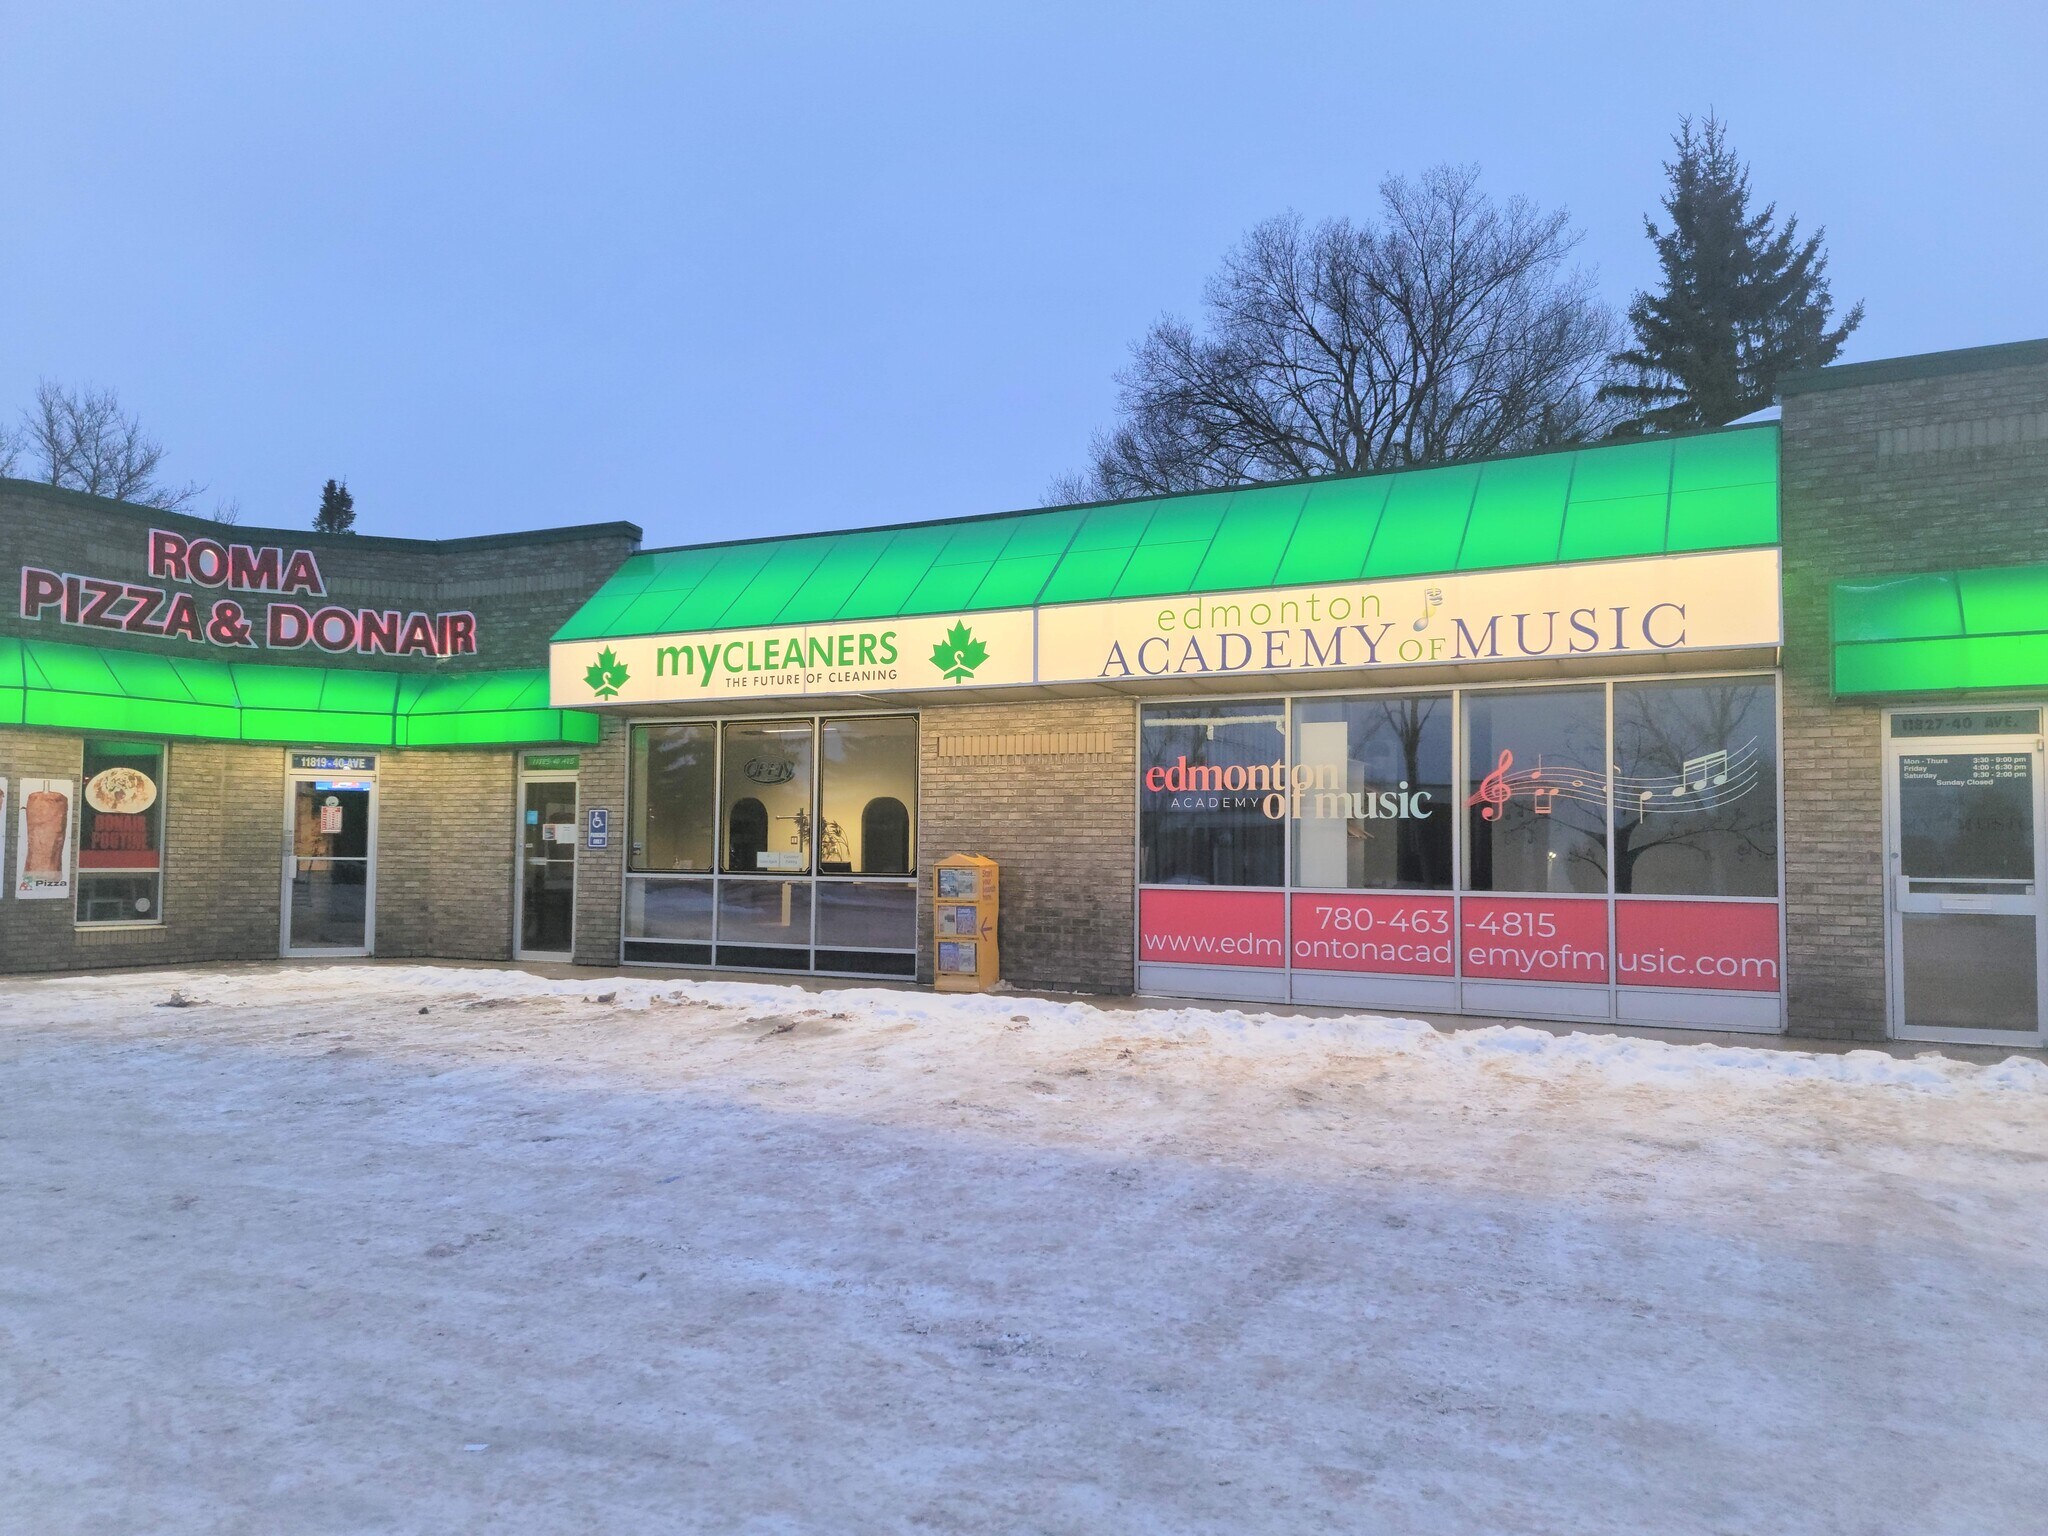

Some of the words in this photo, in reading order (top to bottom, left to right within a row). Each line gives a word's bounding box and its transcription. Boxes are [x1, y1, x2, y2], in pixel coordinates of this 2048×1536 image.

[148, 528, 327, 597] ROMA
[20, 566, 205, 643] PIZZA
[206, 599, 258, 647] &
[267, 603, 477, 657] DONAIR
[1157, 593, 1381, 631] edmonton
[1097, 623, 1396, 677] ACADEMY
[1398, 638, 1446, 662] OF
[1450, 602, 1687, 659] MUSIC
[725, 677, 748, 688] THE
[753, 674, 801, 686] FUTURE
[806, 673, 823, 684] OF
[828, 669, 898, 683] CLEANING
[301, 756, 327, 768] 11819
[333, 758, 344, 768] 40
[346, 758, 366, 768] AVE
[1145, 755, 1340, 792] edmonton
[1904, 765, 1928, 773] Friday
[1904, 772, 1938, 780] Saturday
[1936, 779, 1966, 787] Sunday
[1171, 797, 1259, 808] ACADEMY
[1262, 782, 1311, 820] of
[1315, 781, 1433, 820] music
[35, 879, 67, 888] Pizza
